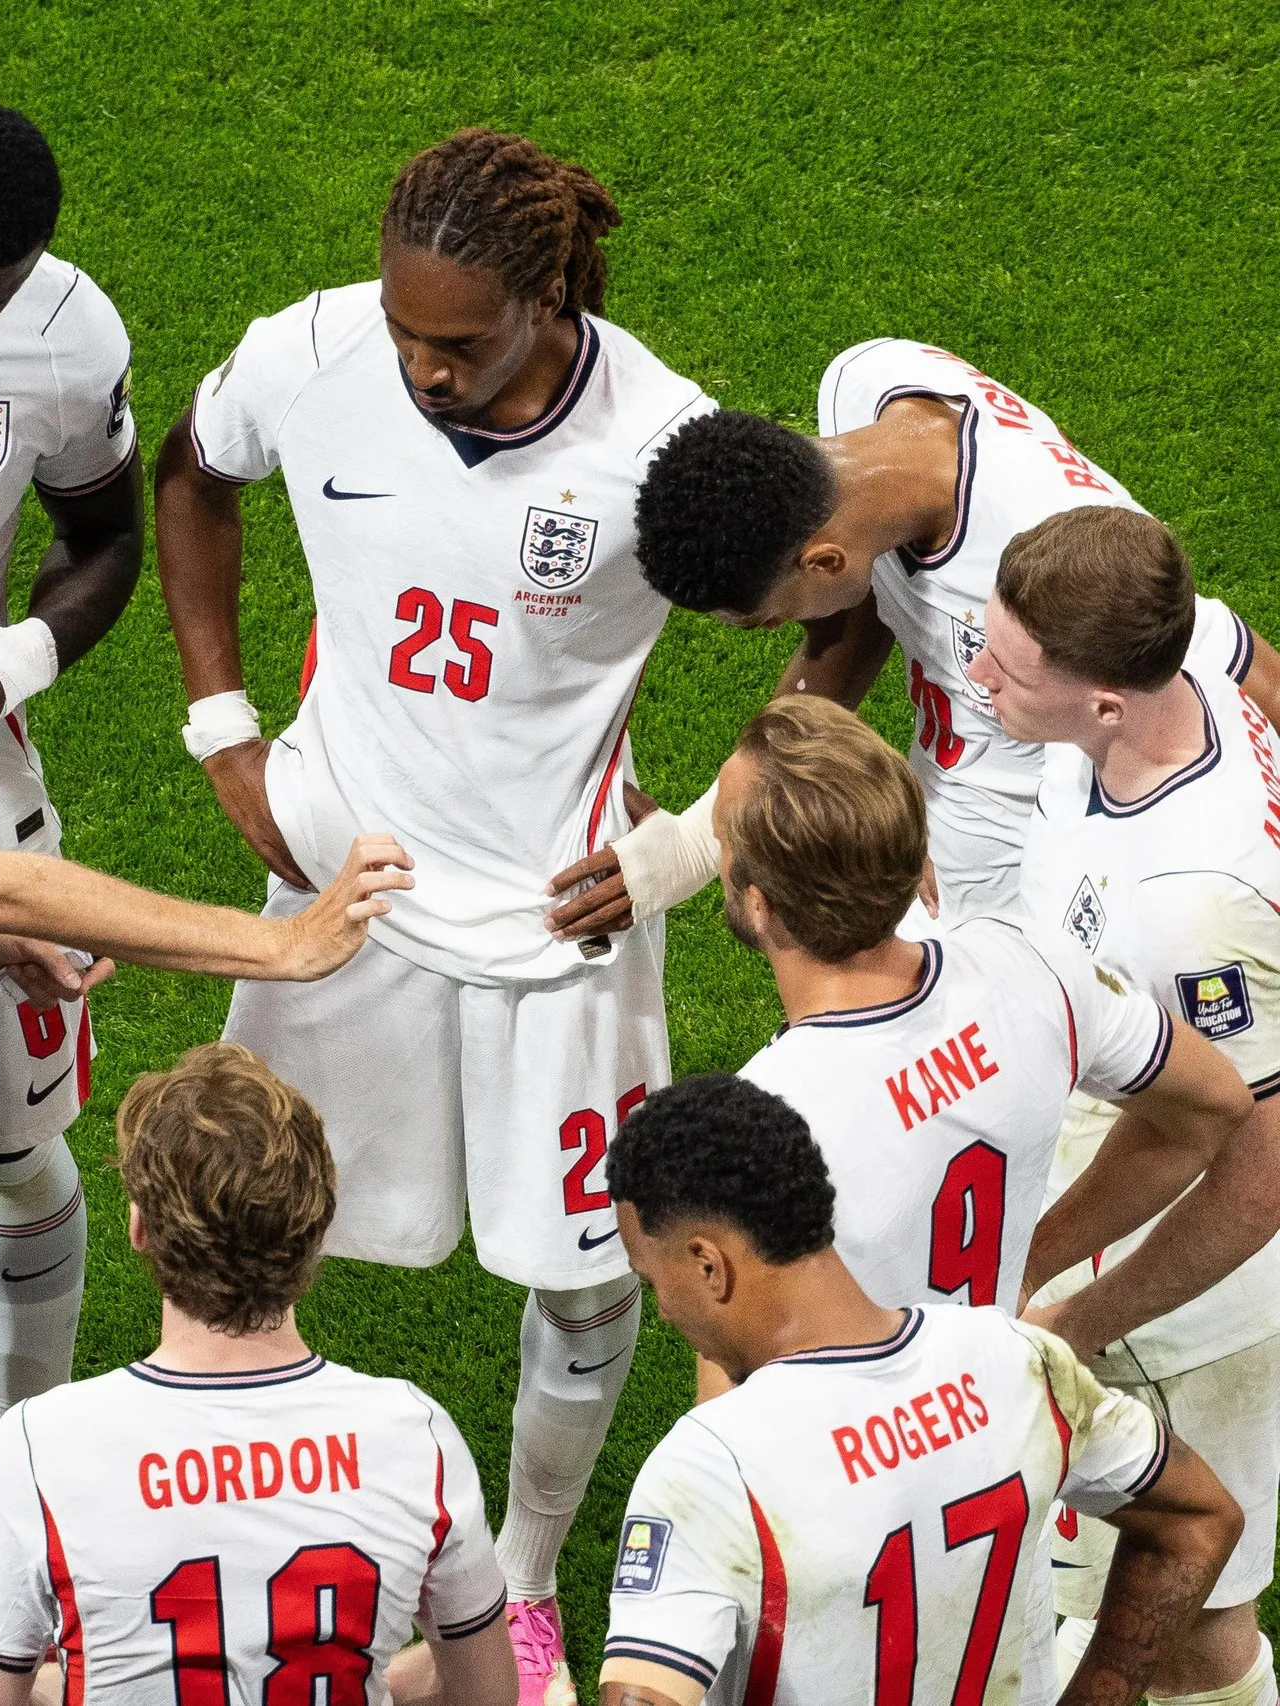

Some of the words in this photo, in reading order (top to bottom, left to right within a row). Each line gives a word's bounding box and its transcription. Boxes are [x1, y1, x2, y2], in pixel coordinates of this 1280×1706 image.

[388, 586, 500, 703] 25
[514, 590, 582, 605] ARGENTINA
[525, 605, 568, 617] 15.07.26
[1195, 1006, 1242, 1028] EDUCATION
[1210, 1023, 1230, 1034] FIFA
[884, 1021, 1000, 1132] KANE
[928, 1139, 1007, 1307] 9
[137, 1431, 361, 1511] GORDON
[830, 1372, 990, 1485] ROGERS
[149, 1541, 382, 1706] 18
[863, 1472, 1030, 1706] 17
